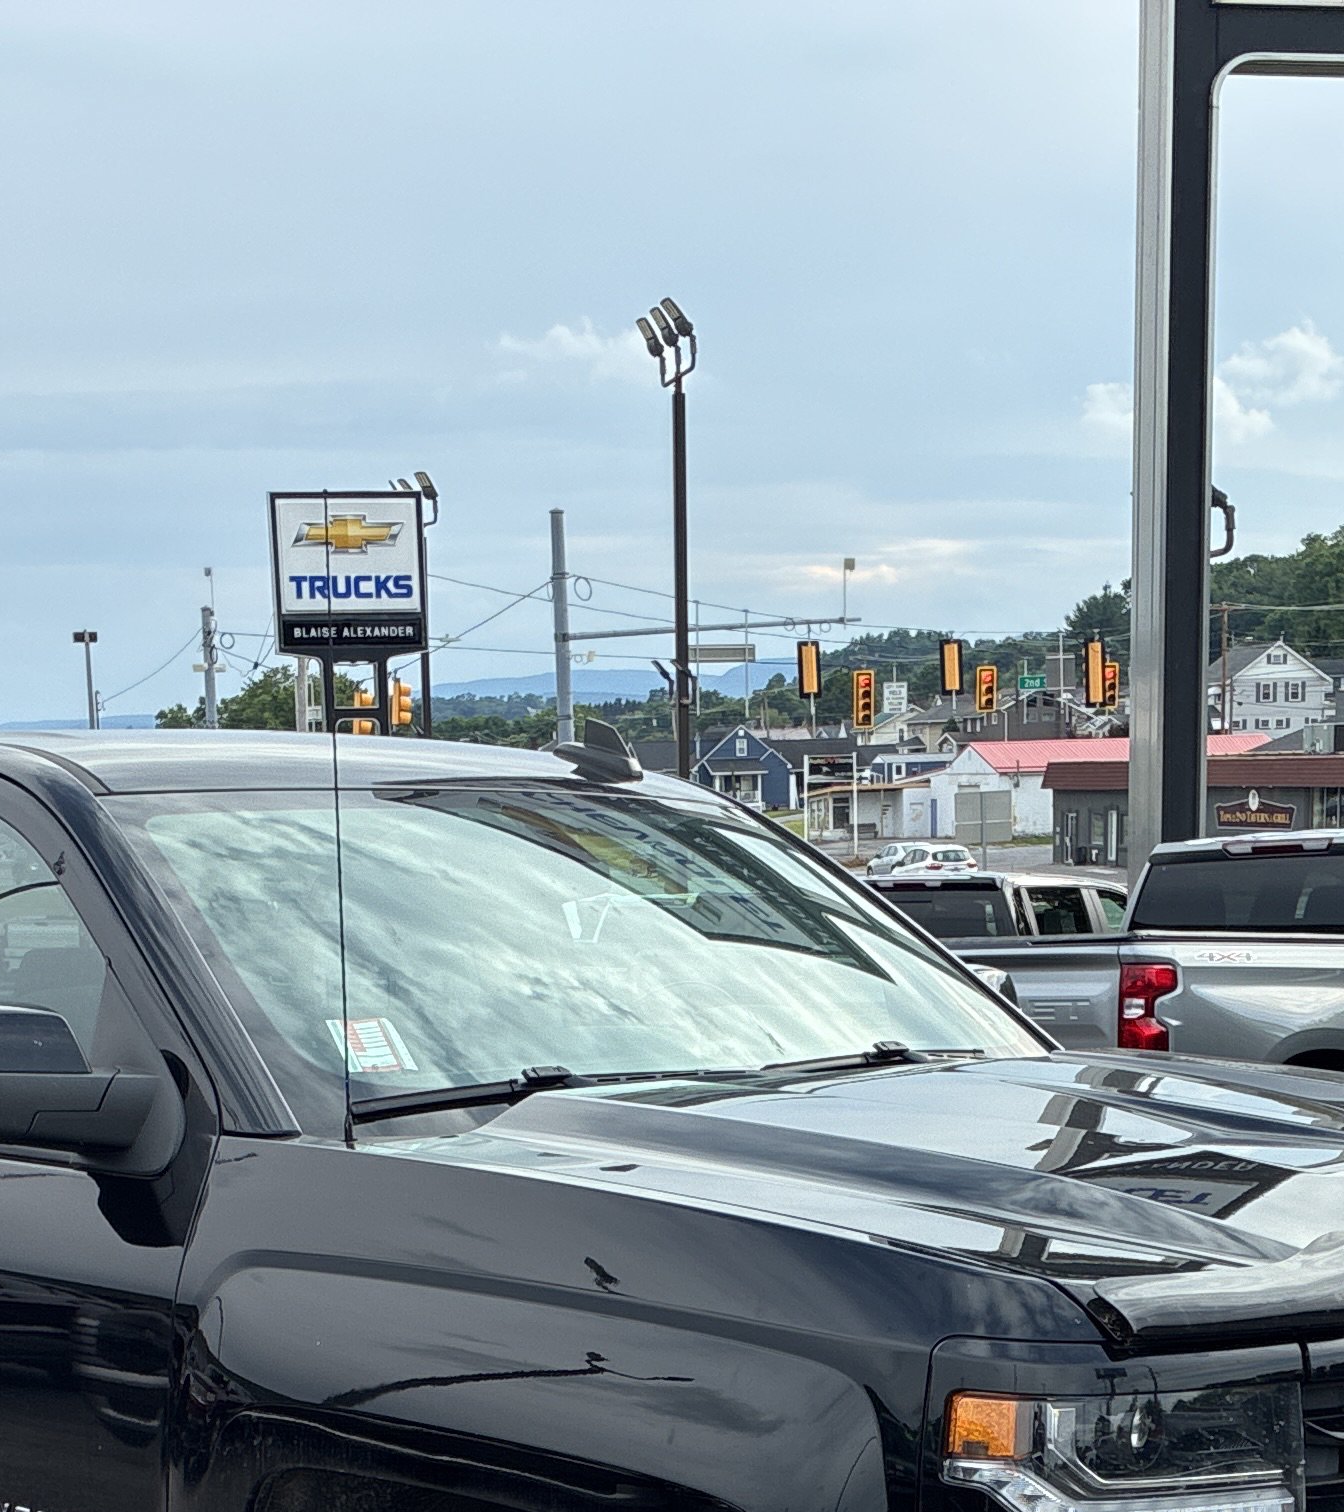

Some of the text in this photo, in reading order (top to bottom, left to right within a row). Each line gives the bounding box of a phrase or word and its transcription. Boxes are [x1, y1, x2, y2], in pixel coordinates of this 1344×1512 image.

[289, 575, 413, 599] TRUCKS
[293, 625, 414, 638] BLAISE ALEXANDER
[1024, 678, 1041, 688] 2nd
